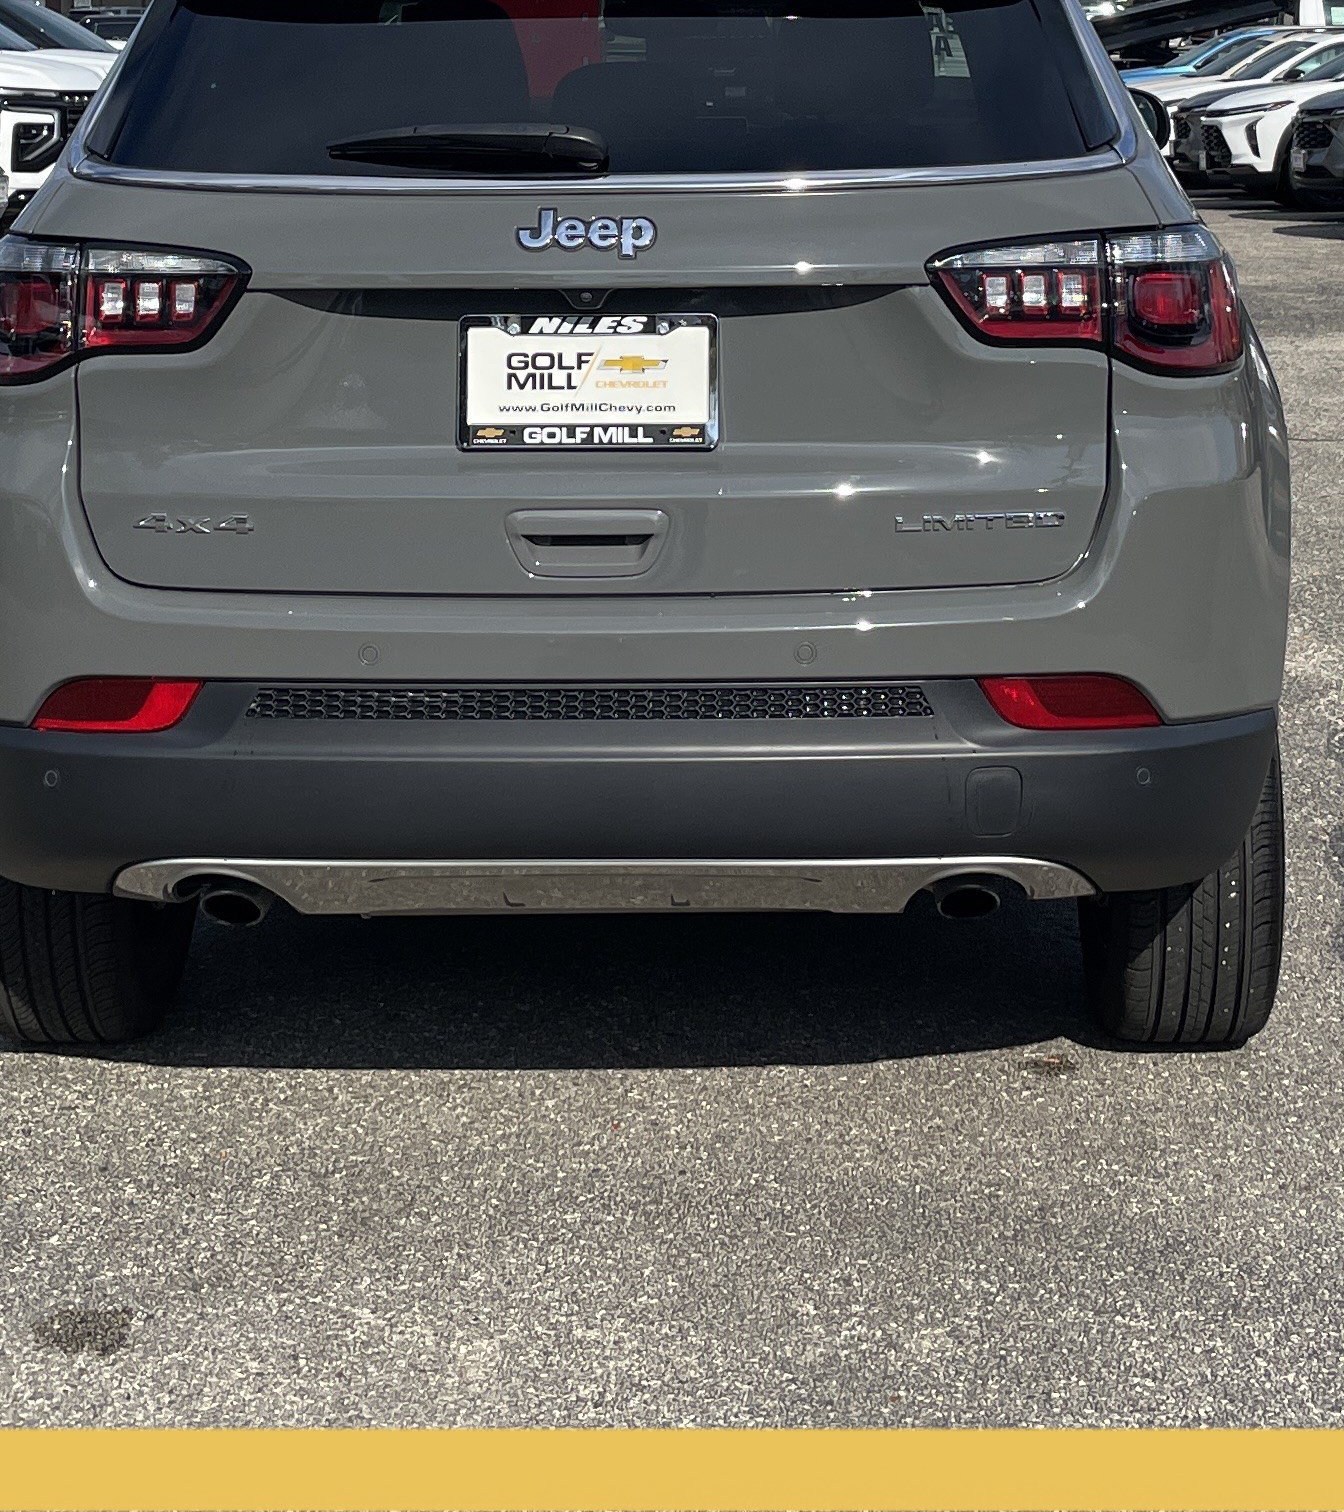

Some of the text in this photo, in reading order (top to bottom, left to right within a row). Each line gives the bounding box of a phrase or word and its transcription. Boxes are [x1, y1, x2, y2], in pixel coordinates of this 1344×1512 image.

[514, 205, 657, 260] Jeep
[528, 316, 648, 334] NILES
[506, 352, 595, 371] GOLF
[506, 372, 578, 391] MILL
[595, 380, 669, 389] CHEVROLET
[498, 402, 677, 414] www.GolfMillChevy.com
[523, 426, 653, 444] GOLF MILL
[894, 511, 1066, 533] LIMITED
